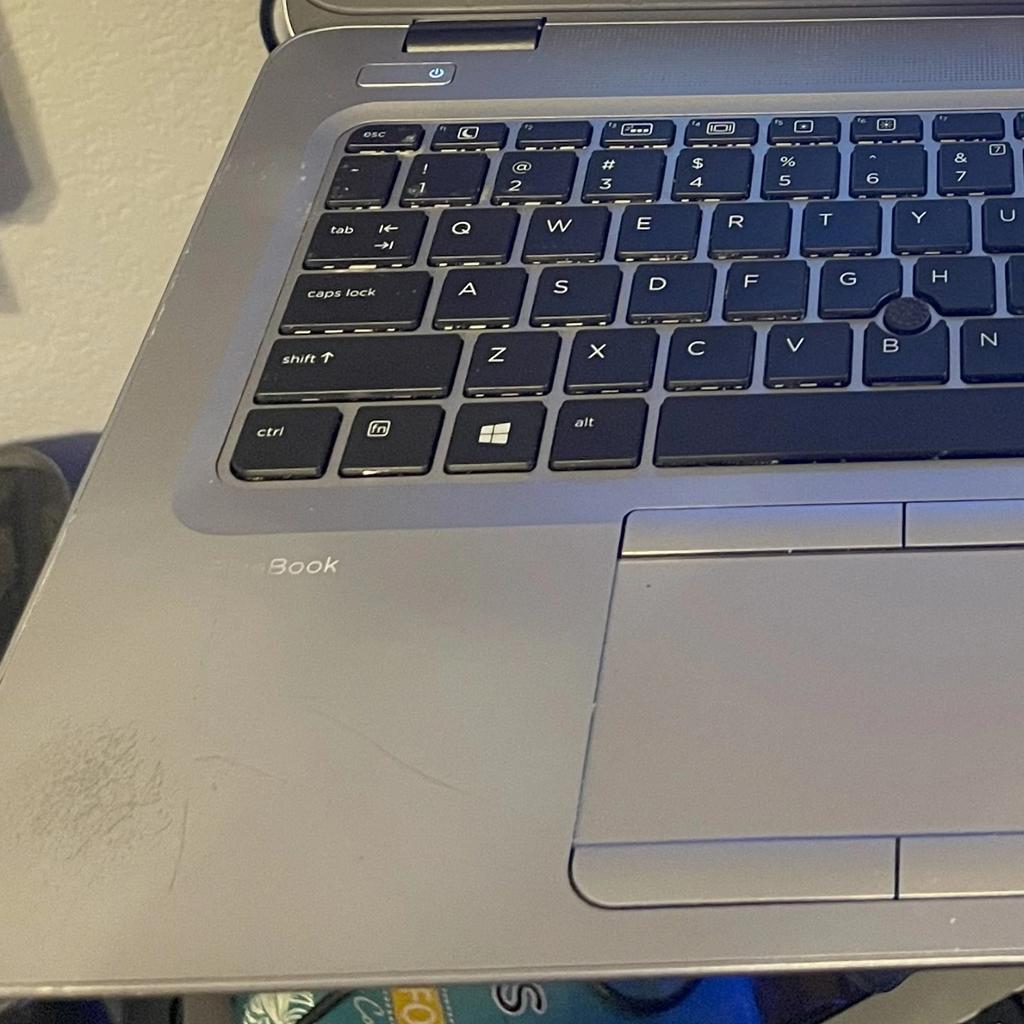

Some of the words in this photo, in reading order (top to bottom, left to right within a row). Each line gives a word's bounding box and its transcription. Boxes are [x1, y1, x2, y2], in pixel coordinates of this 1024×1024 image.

[692, 158, 703, 169] $
[781, 157, 795, 166] %
[955, 153, 967, 163] &
[513, 162, 531, 173] @
[602, 160, 615, 169] #
[779, 175, 790, 186] 5
[867, 173, 879, 183] 6
[956, 171, 966, 181] 7
[508, 180, 521, 191] 2
[600, 178, 612, 189] 3
[690, 177, 702, 187] 4
[420, 183, 425, 193] 1
[819, 214, 832, 225] T
[912, 212, 926, 223] Y
[1001, 209, 1015, 221] U
[547, 219, 572, 232] W
[637, 217, 651, 229] E
[729, 215, 743, 228] R
[452, 222, 470, 234] Q
[745, 275, 759, 288] F
[840, 272, 856, 285] G
[933, 270, 947, 282] H
[458, 283, 476, 295] A
[554, 280, 568, 293] S
[649, 277, 666, 290] D
[346, 288, 375, 296] lock
[981, 332, 997, 346] N
[688, 341, 705, 355] C
[787, 338, 804, 352] V
[883, 339, 899, 352] B
[488, 347, 506, 362] Z
[588, 344, 606, 358] X
[283, 354, 315, 363] shift
[575, 418, 593, 427] alt
[257, 427, 284, 437] ctrl
[270, 556, 340, 575] Book
